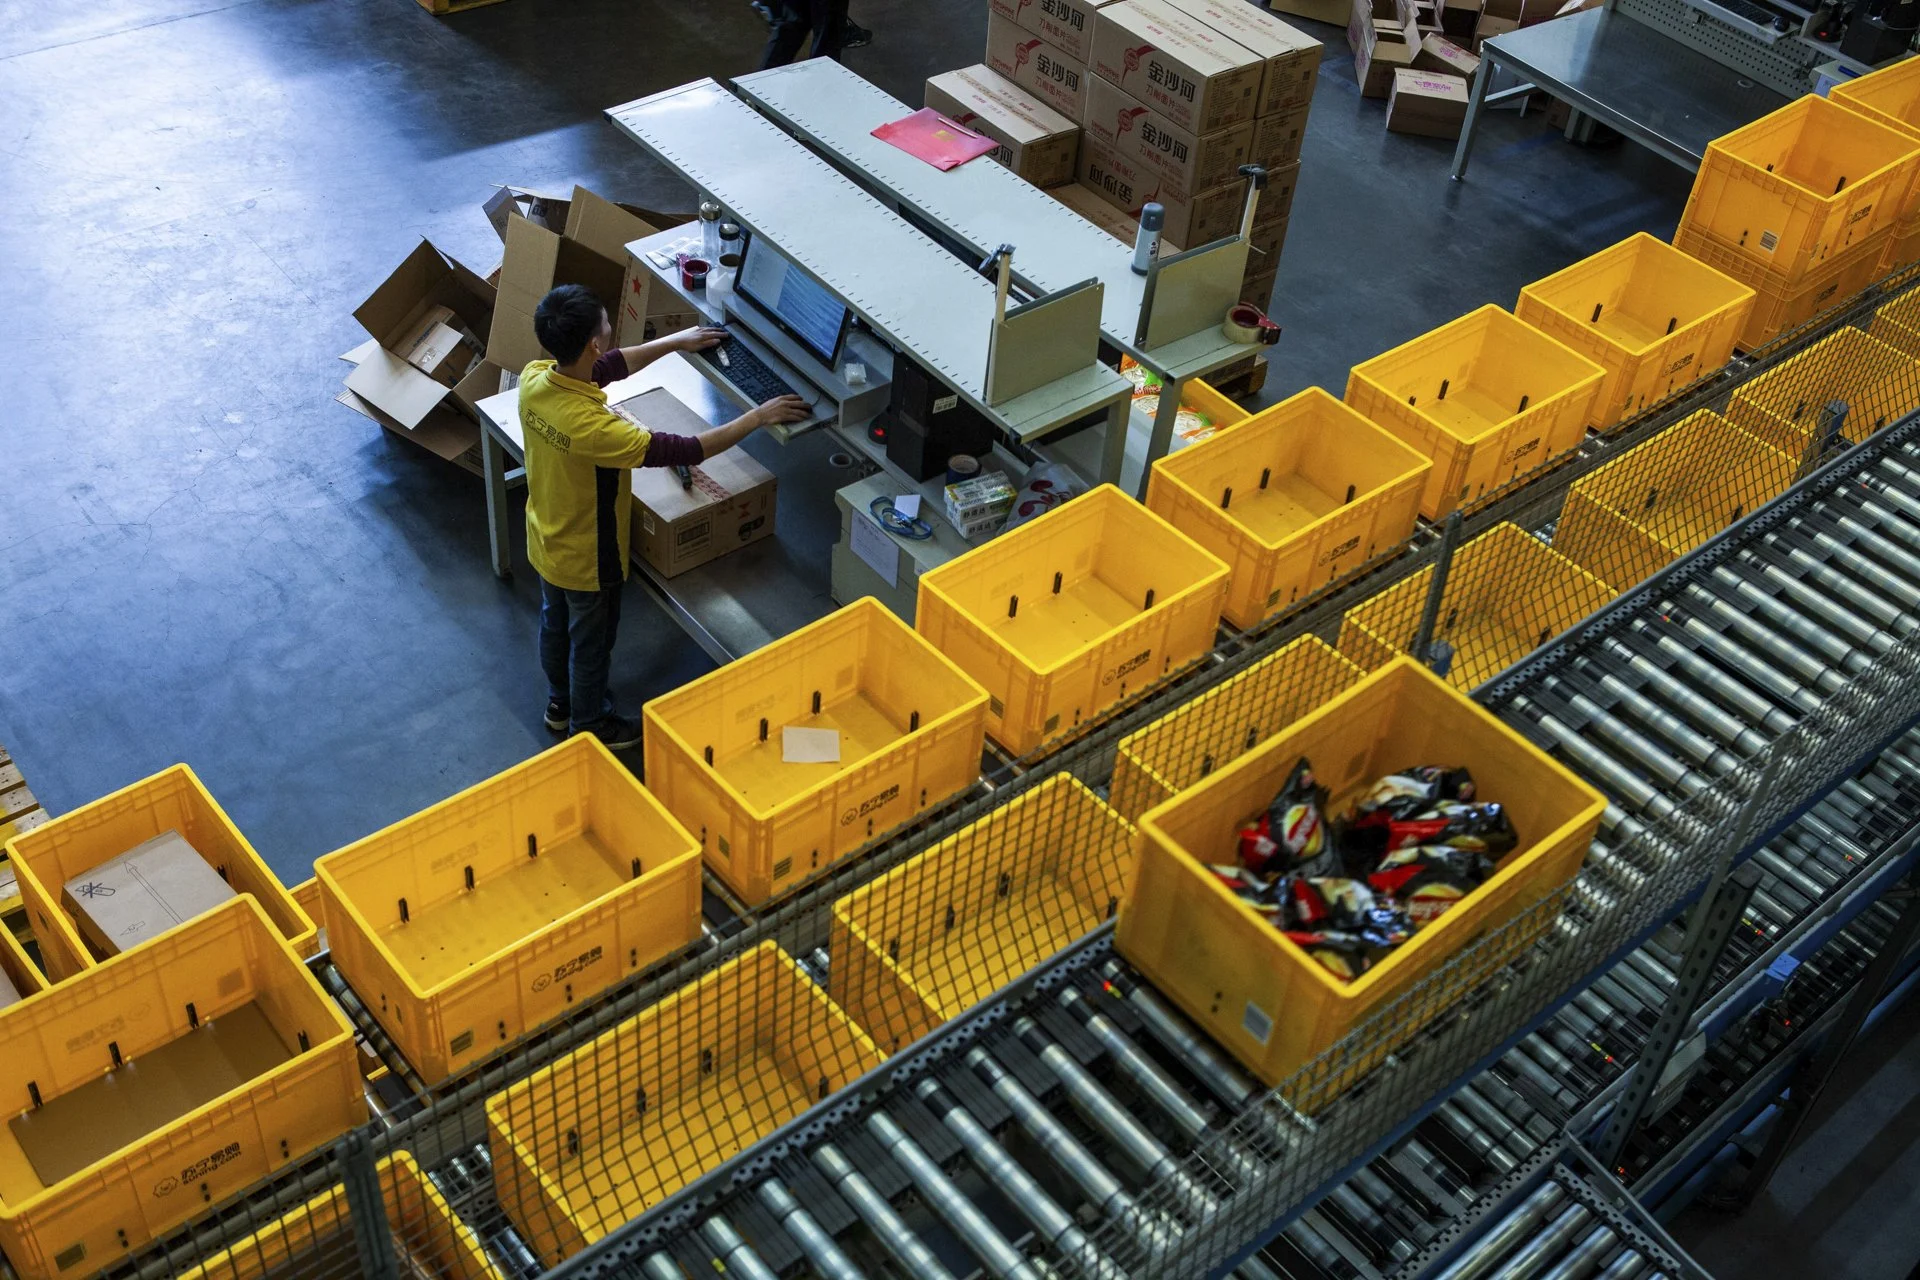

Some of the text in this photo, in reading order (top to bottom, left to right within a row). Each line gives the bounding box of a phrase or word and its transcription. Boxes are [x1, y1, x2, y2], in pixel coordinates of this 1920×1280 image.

[1036, 53, 1080, 92] 金沙河
[1147, 60, 1197, 103] 金沙河
[1141, 121, 1189, 164] 金沙河
[182, 1151, 242, 1185] suning.com
